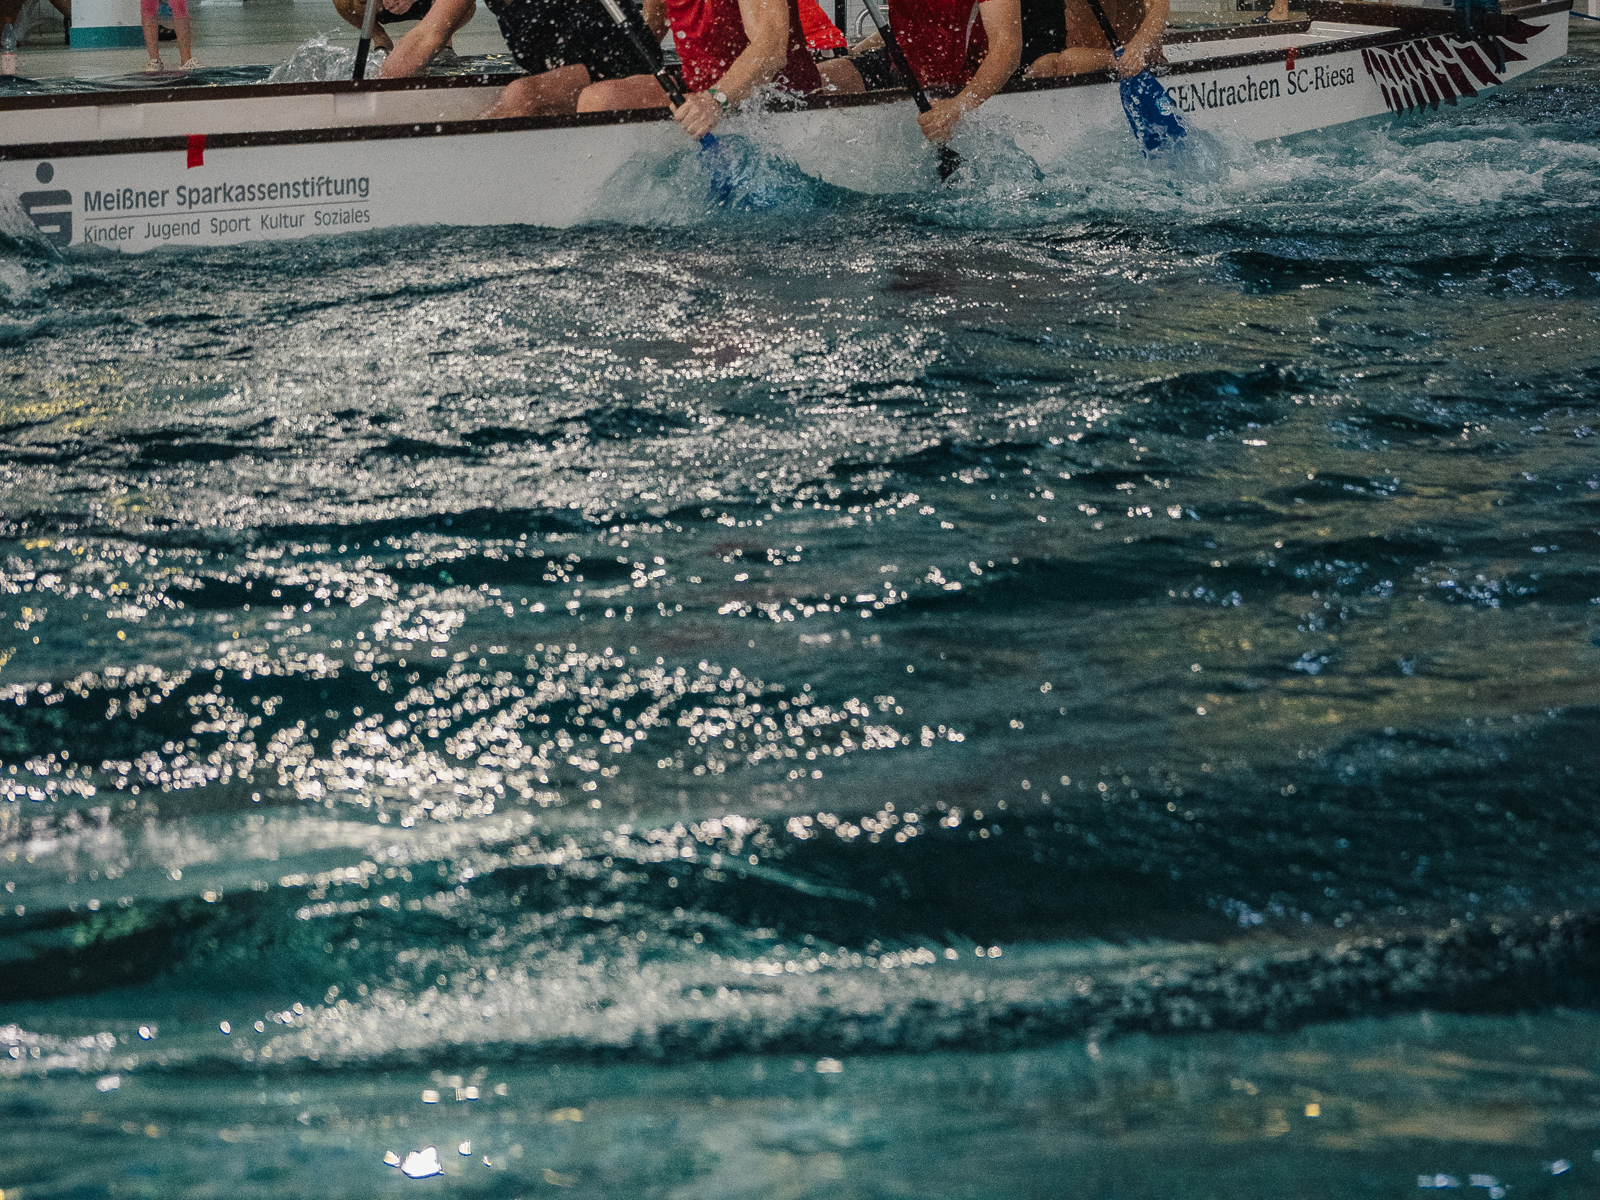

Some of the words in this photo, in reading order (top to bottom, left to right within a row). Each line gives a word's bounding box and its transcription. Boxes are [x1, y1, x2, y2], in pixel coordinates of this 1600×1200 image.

[1287, 64, 1355, 95] SC-Riesa
[84, 187, 170, 212] Meißner
[176, 176, 370, 210] Sparkassenstiftung
[84, 224, 135, 243] Kinder
[144, 219, 200, 240] Jugend
[210, 216, 251, 236] Sport
[260, 213, 305, 230] Kultur
[314, 208, 370, 226] Soziales
